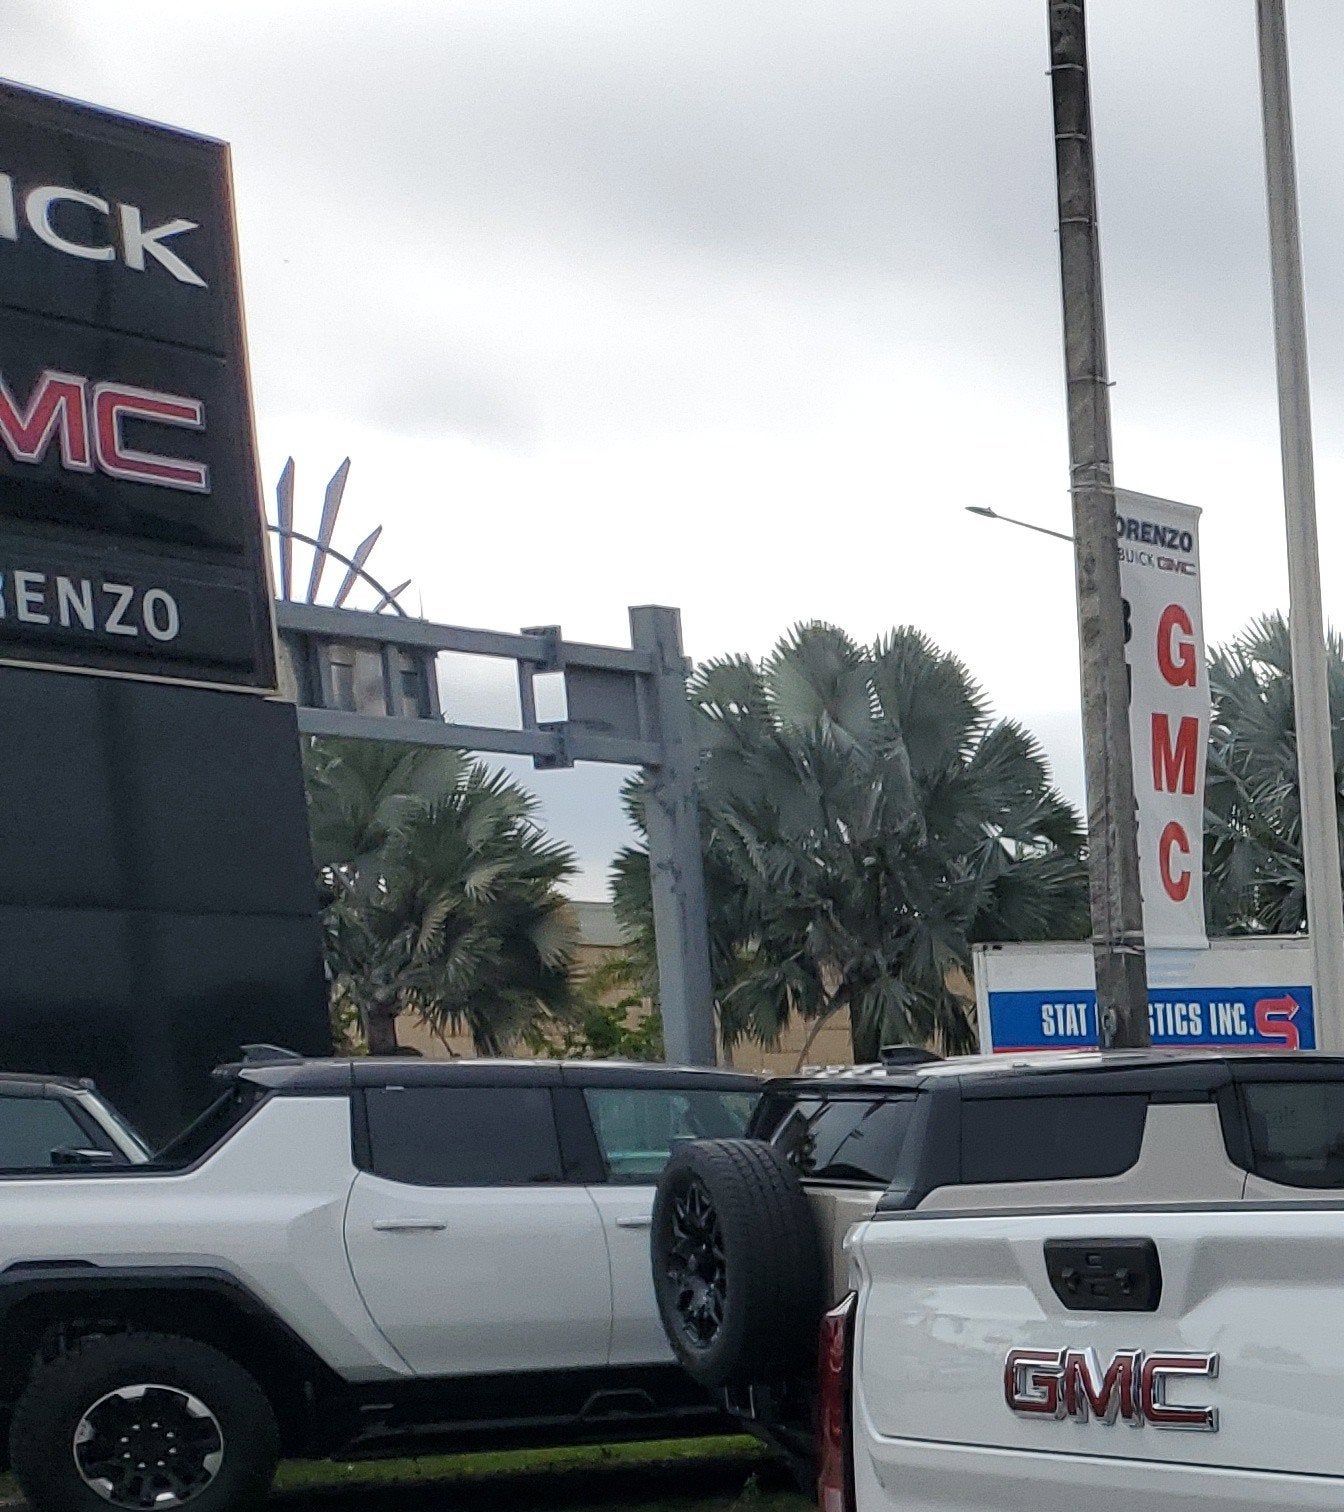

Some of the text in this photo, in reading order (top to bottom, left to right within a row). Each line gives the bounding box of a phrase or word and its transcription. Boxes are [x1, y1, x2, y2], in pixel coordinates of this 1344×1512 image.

[1157, 557, 1197, 575] GMC
[0, 568, 180, 642] ENZO
[1152, 604, 1199, 902] GMC
[1041, 1003, 1087, 1037] STAT
[1209, 1003, 1254, 1036] INC.
[1004, 1347, 1219, 1432] GMC
